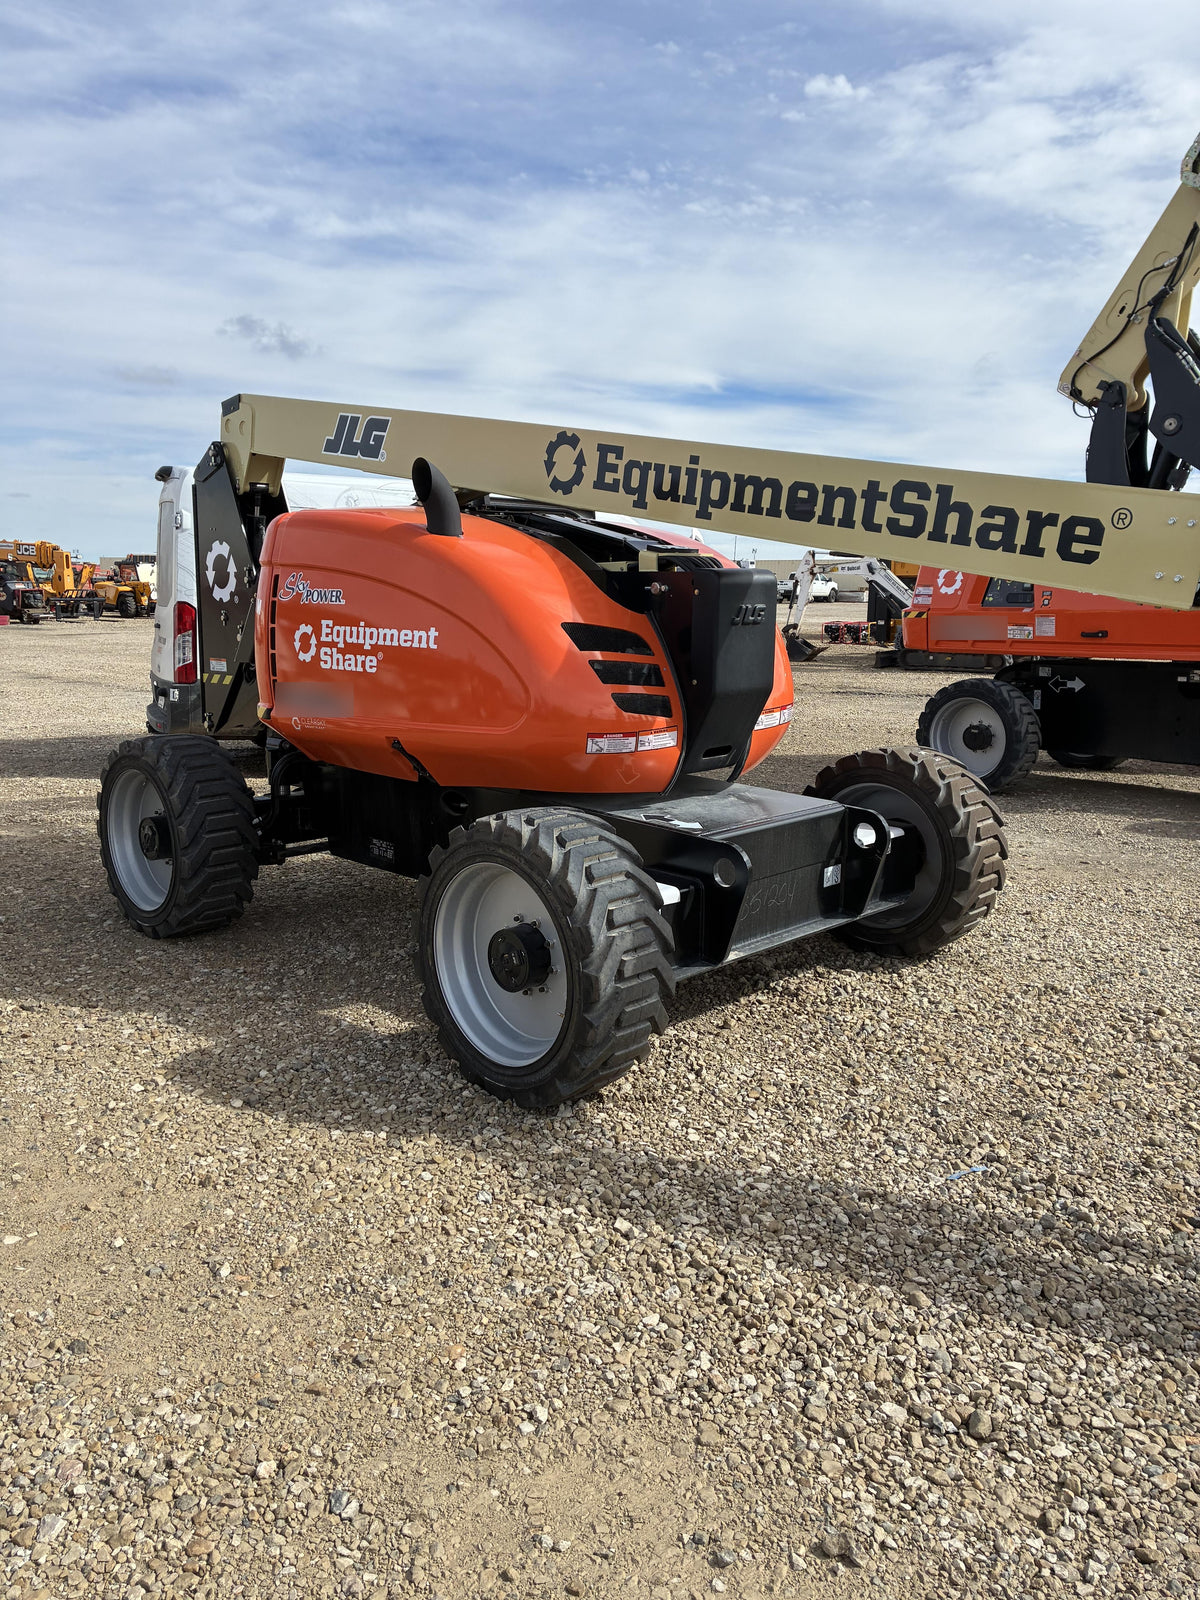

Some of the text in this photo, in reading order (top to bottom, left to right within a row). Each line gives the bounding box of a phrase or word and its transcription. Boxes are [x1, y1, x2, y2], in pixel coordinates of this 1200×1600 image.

[17, 544, 36, 556] JCB
[731, 603, 767, 626] JLG
[320, 619, 439, 650] Equipment
